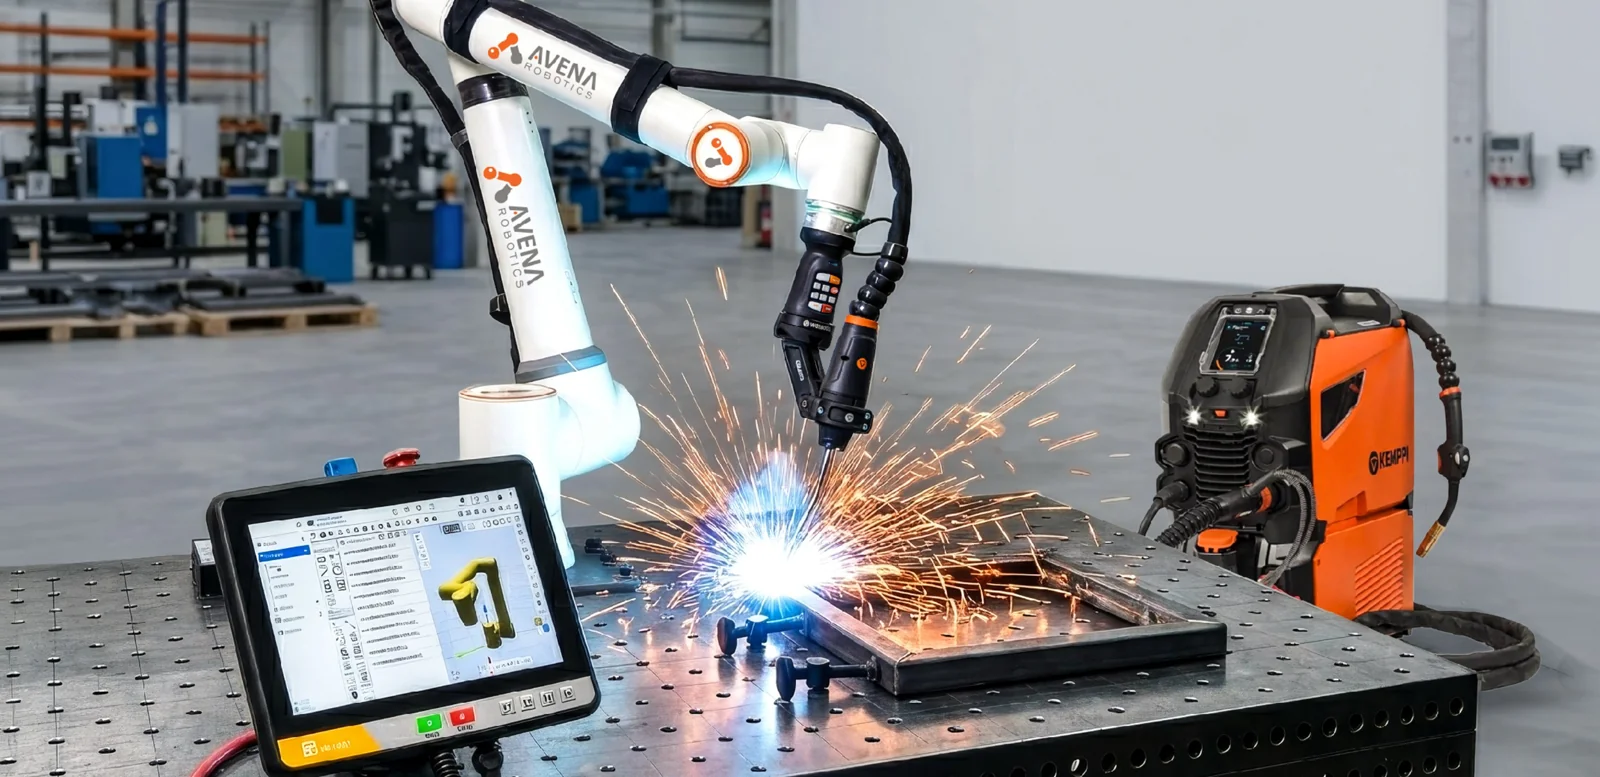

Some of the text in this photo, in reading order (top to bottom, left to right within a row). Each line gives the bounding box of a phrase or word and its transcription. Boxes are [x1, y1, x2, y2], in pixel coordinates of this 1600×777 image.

[524, 62, 593, 100] ROBOTICS
[528, 46, 597, 91] AVENA
[498, 207, 524, 289] ROBOTICS
[509, 205, 544, 286] AVENA
[1379, 445, 1409, 469] KEMPPI
